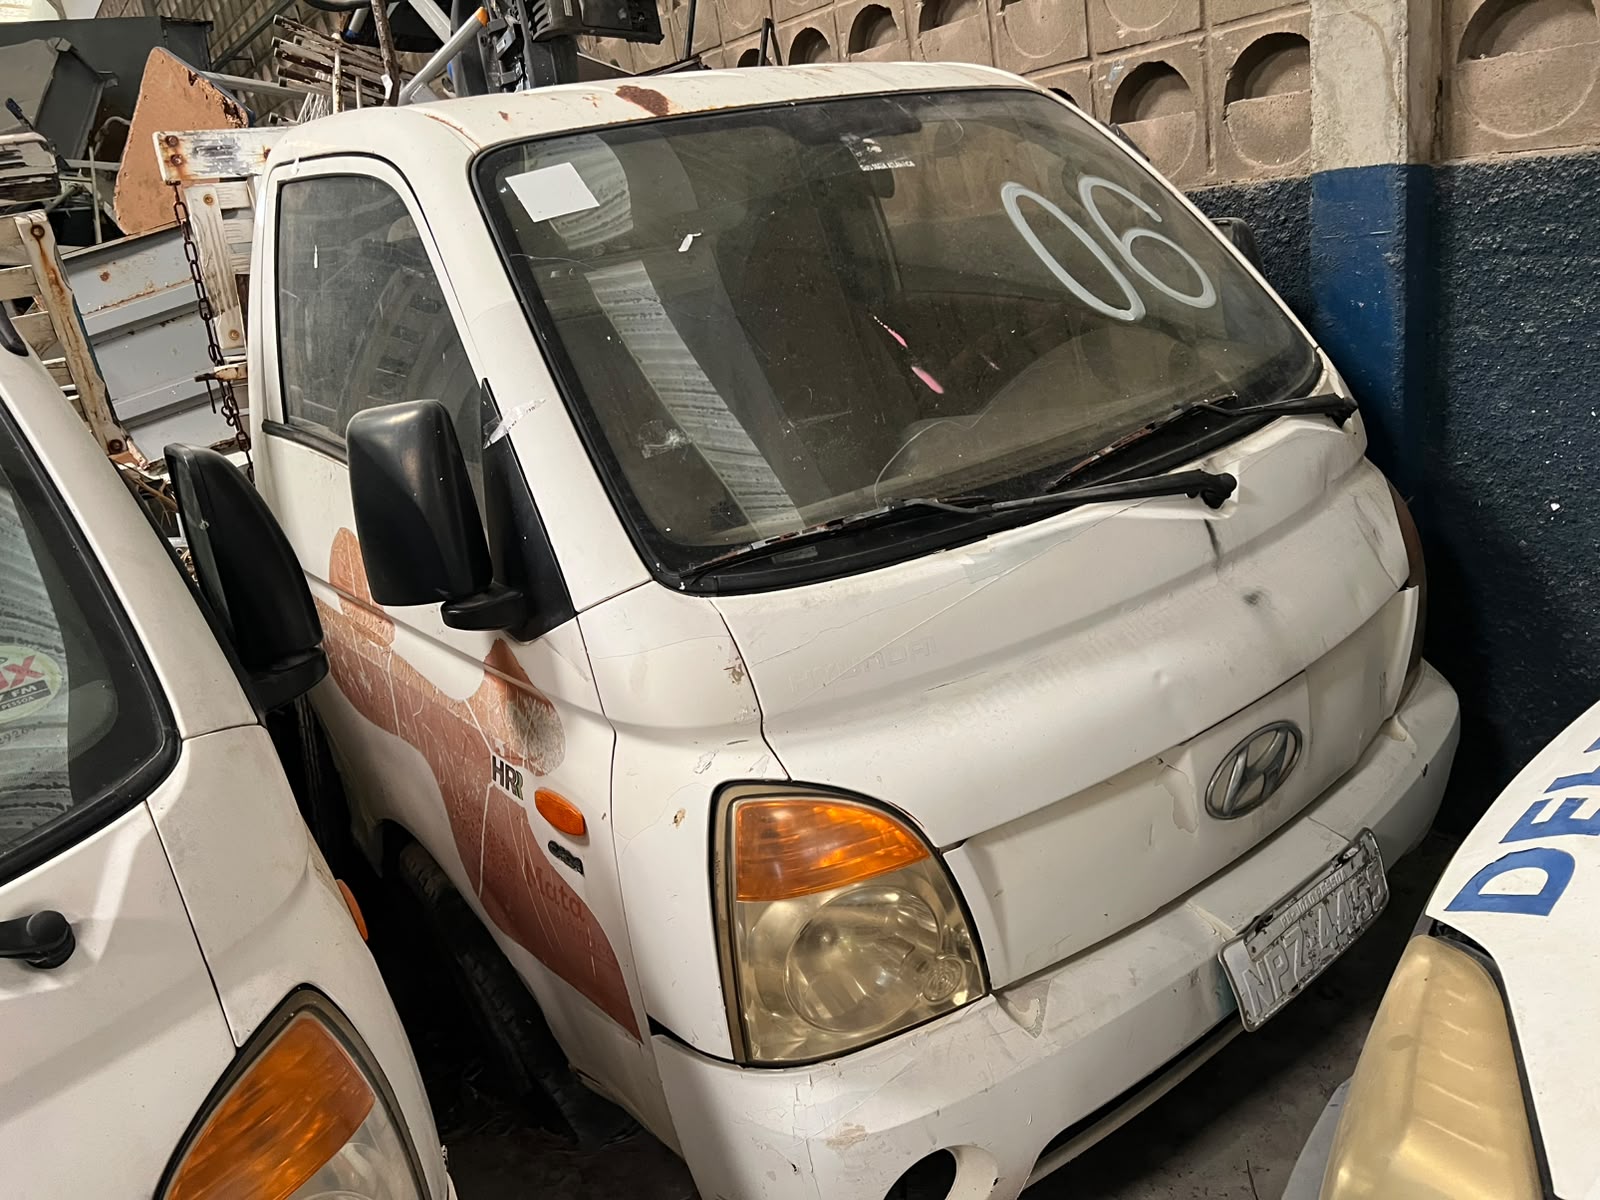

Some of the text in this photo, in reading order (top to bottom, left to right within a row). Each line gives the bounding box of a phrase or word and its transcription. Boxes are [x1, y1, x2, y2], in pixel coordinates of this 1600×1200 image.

[1000, 172, 1217, 322] 06
[1, 696, 34, 710] PESSOA
[11, 685, 37, 697] FM
[524, 858, 585, 923] Mata
